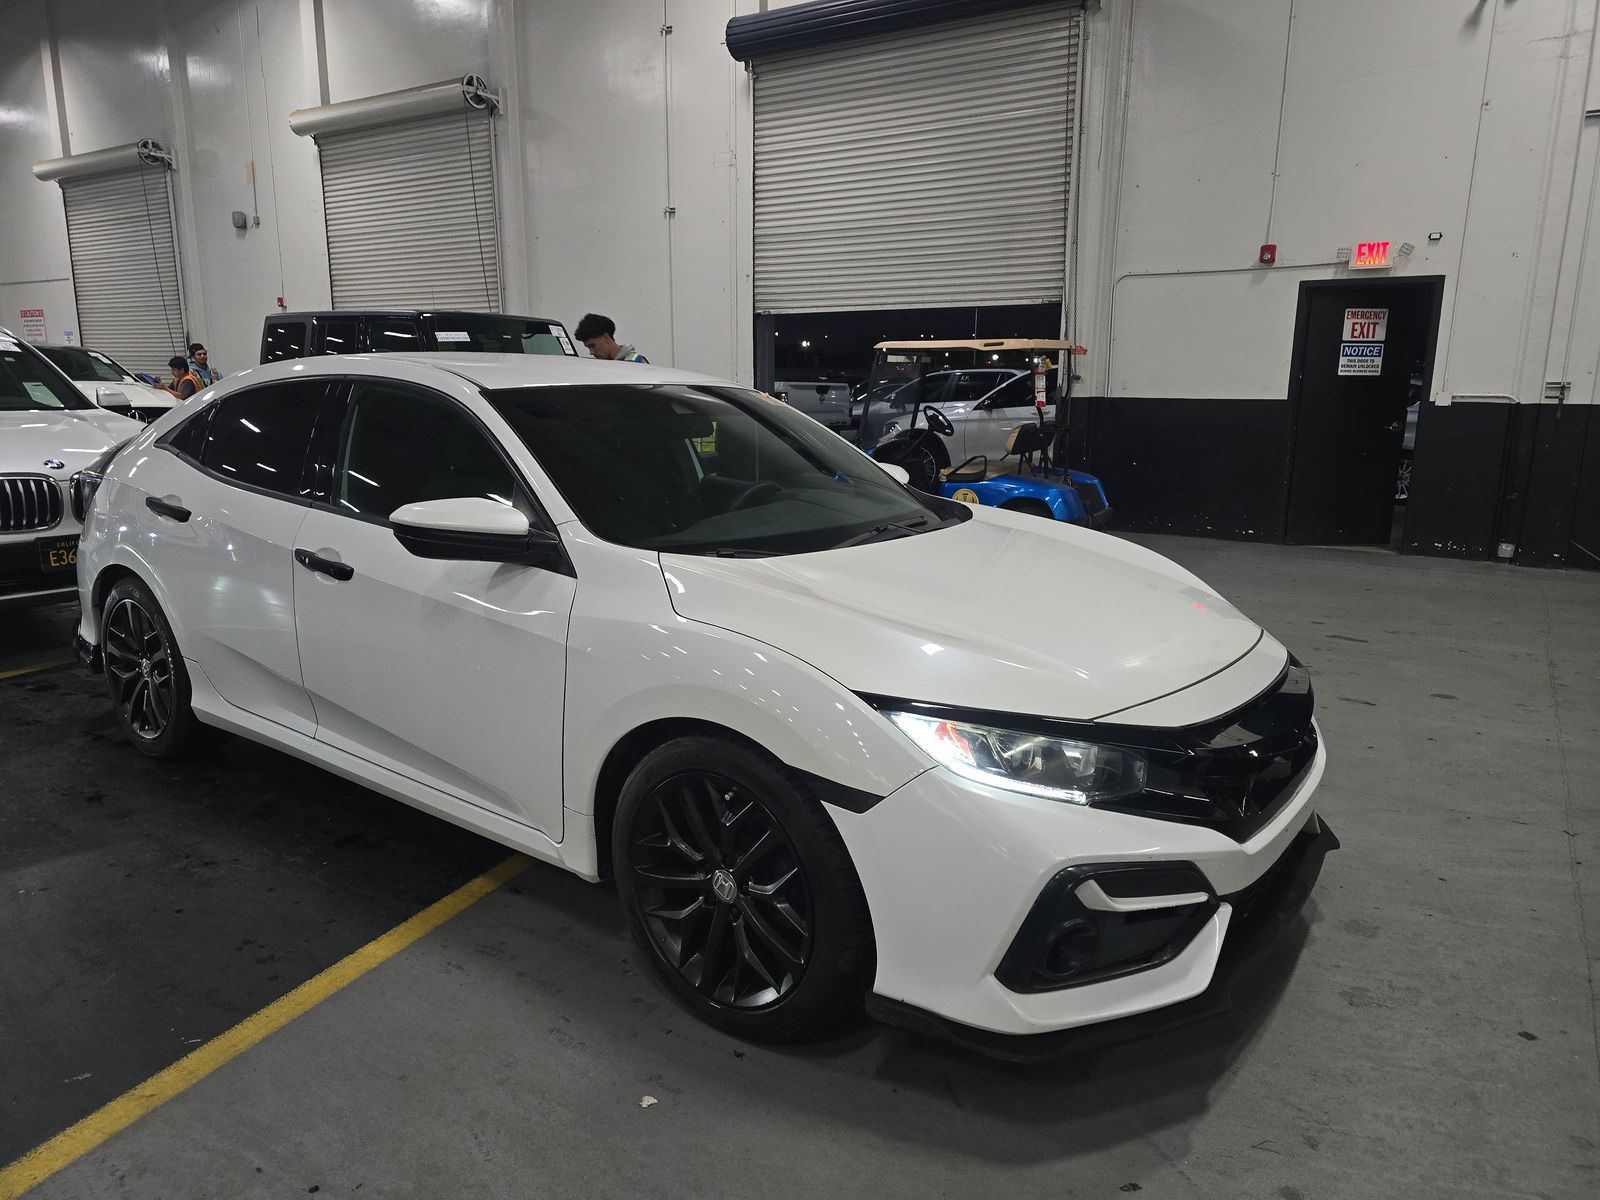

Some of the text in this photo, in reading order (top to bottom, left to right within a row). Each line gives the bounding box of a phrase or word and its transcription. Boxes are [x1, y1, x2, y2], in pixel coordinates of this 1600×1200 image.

[1356, 241, 1389, 265] EXIT
[1346, 310, 1387, 320] EMERGENCY
[1350, 321, 1379, 339] EXIT
[1343, 346, 1381, 356] NOTICE
